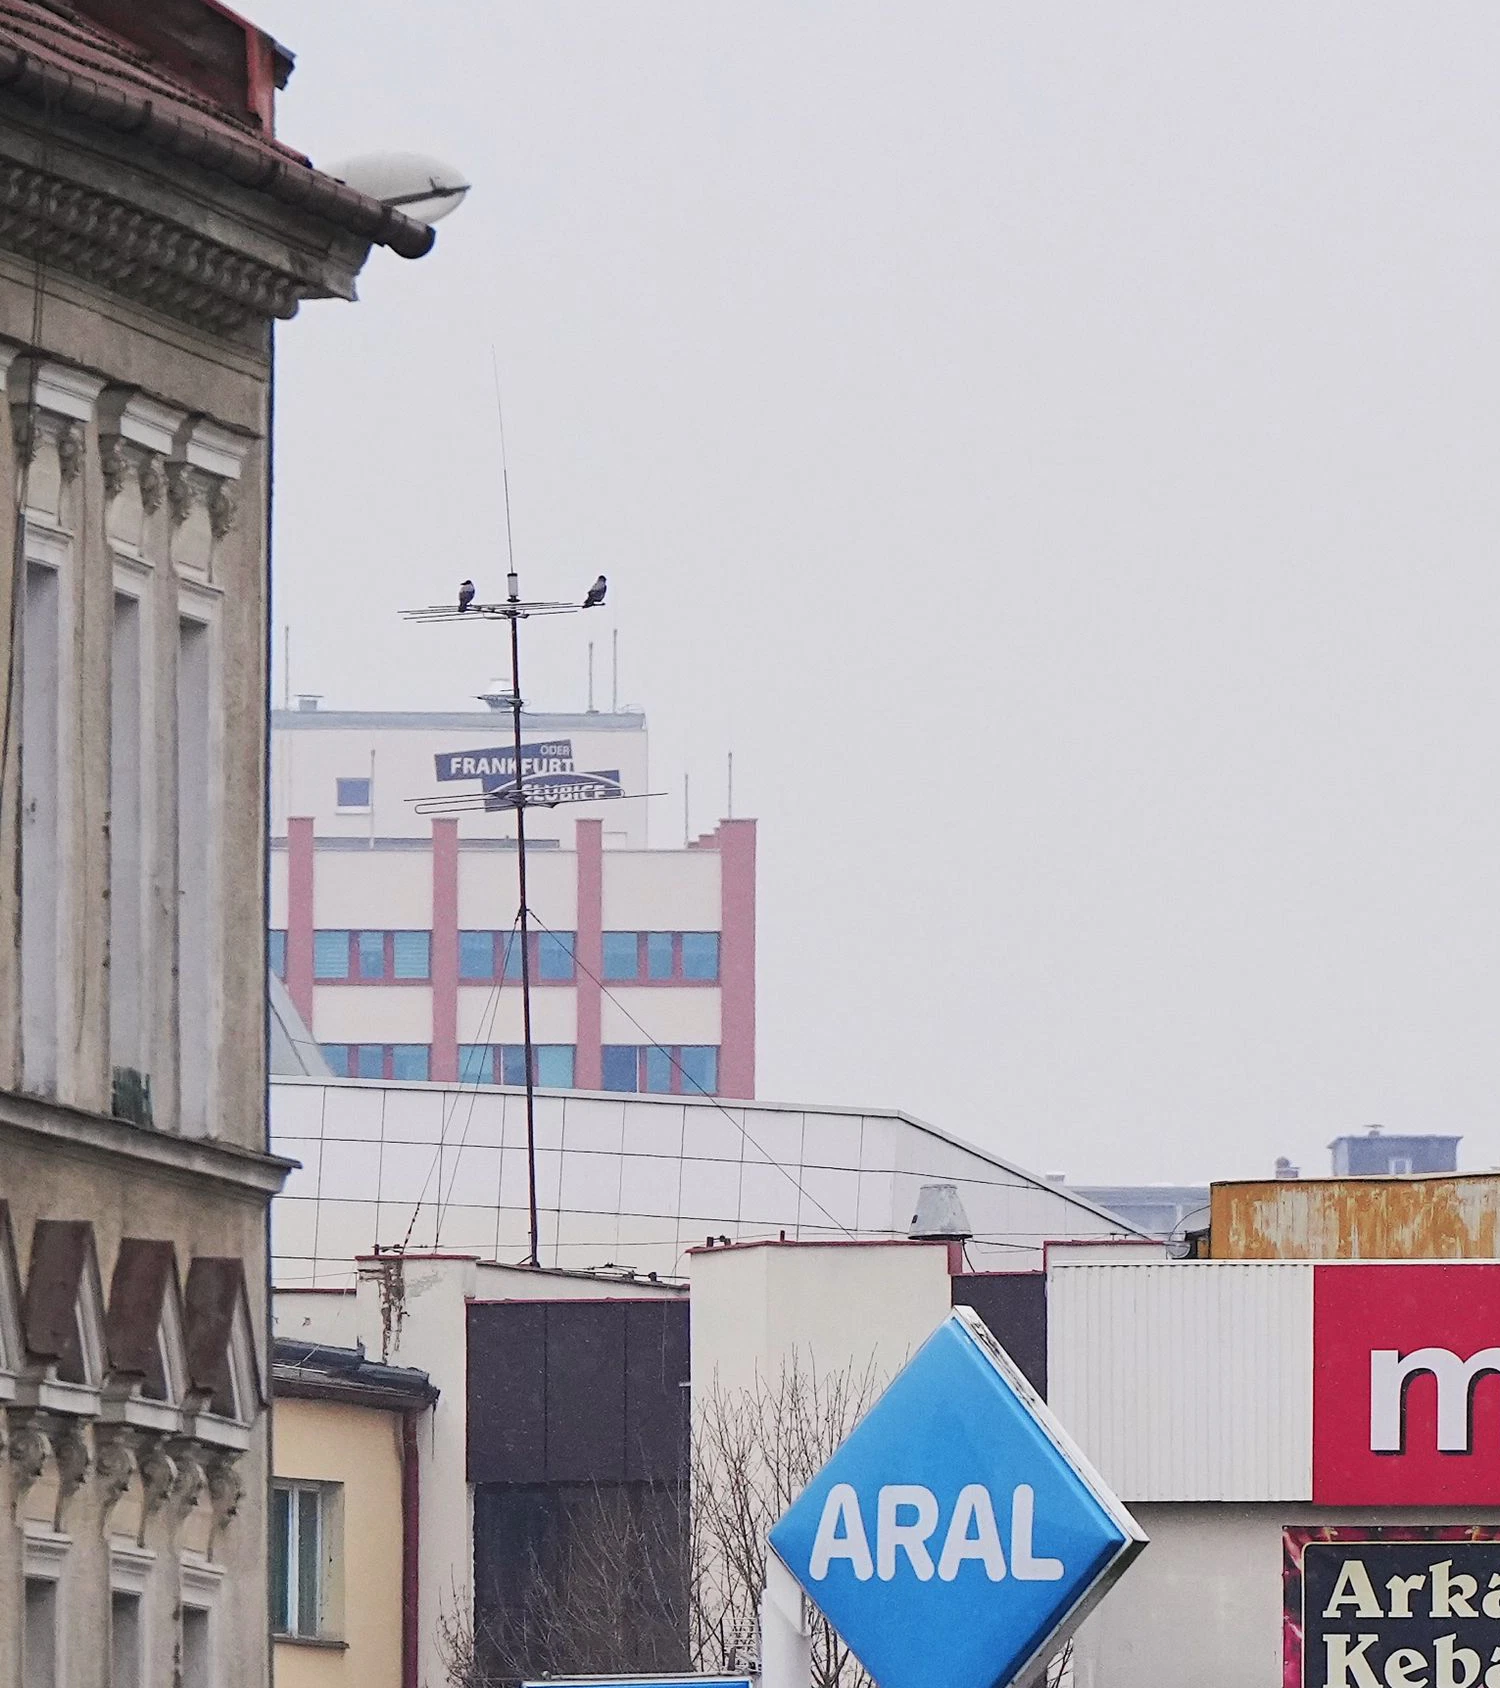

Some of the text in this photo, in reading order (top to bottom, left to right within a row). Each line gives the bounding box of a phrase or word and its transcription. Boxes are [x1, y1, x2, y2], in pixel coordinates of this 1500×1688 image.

[540, 744, 570, 756] ODER
[450, 757, 574, 775] FRANKFURT
[808, 1483, 1065, 1582] ARAL
